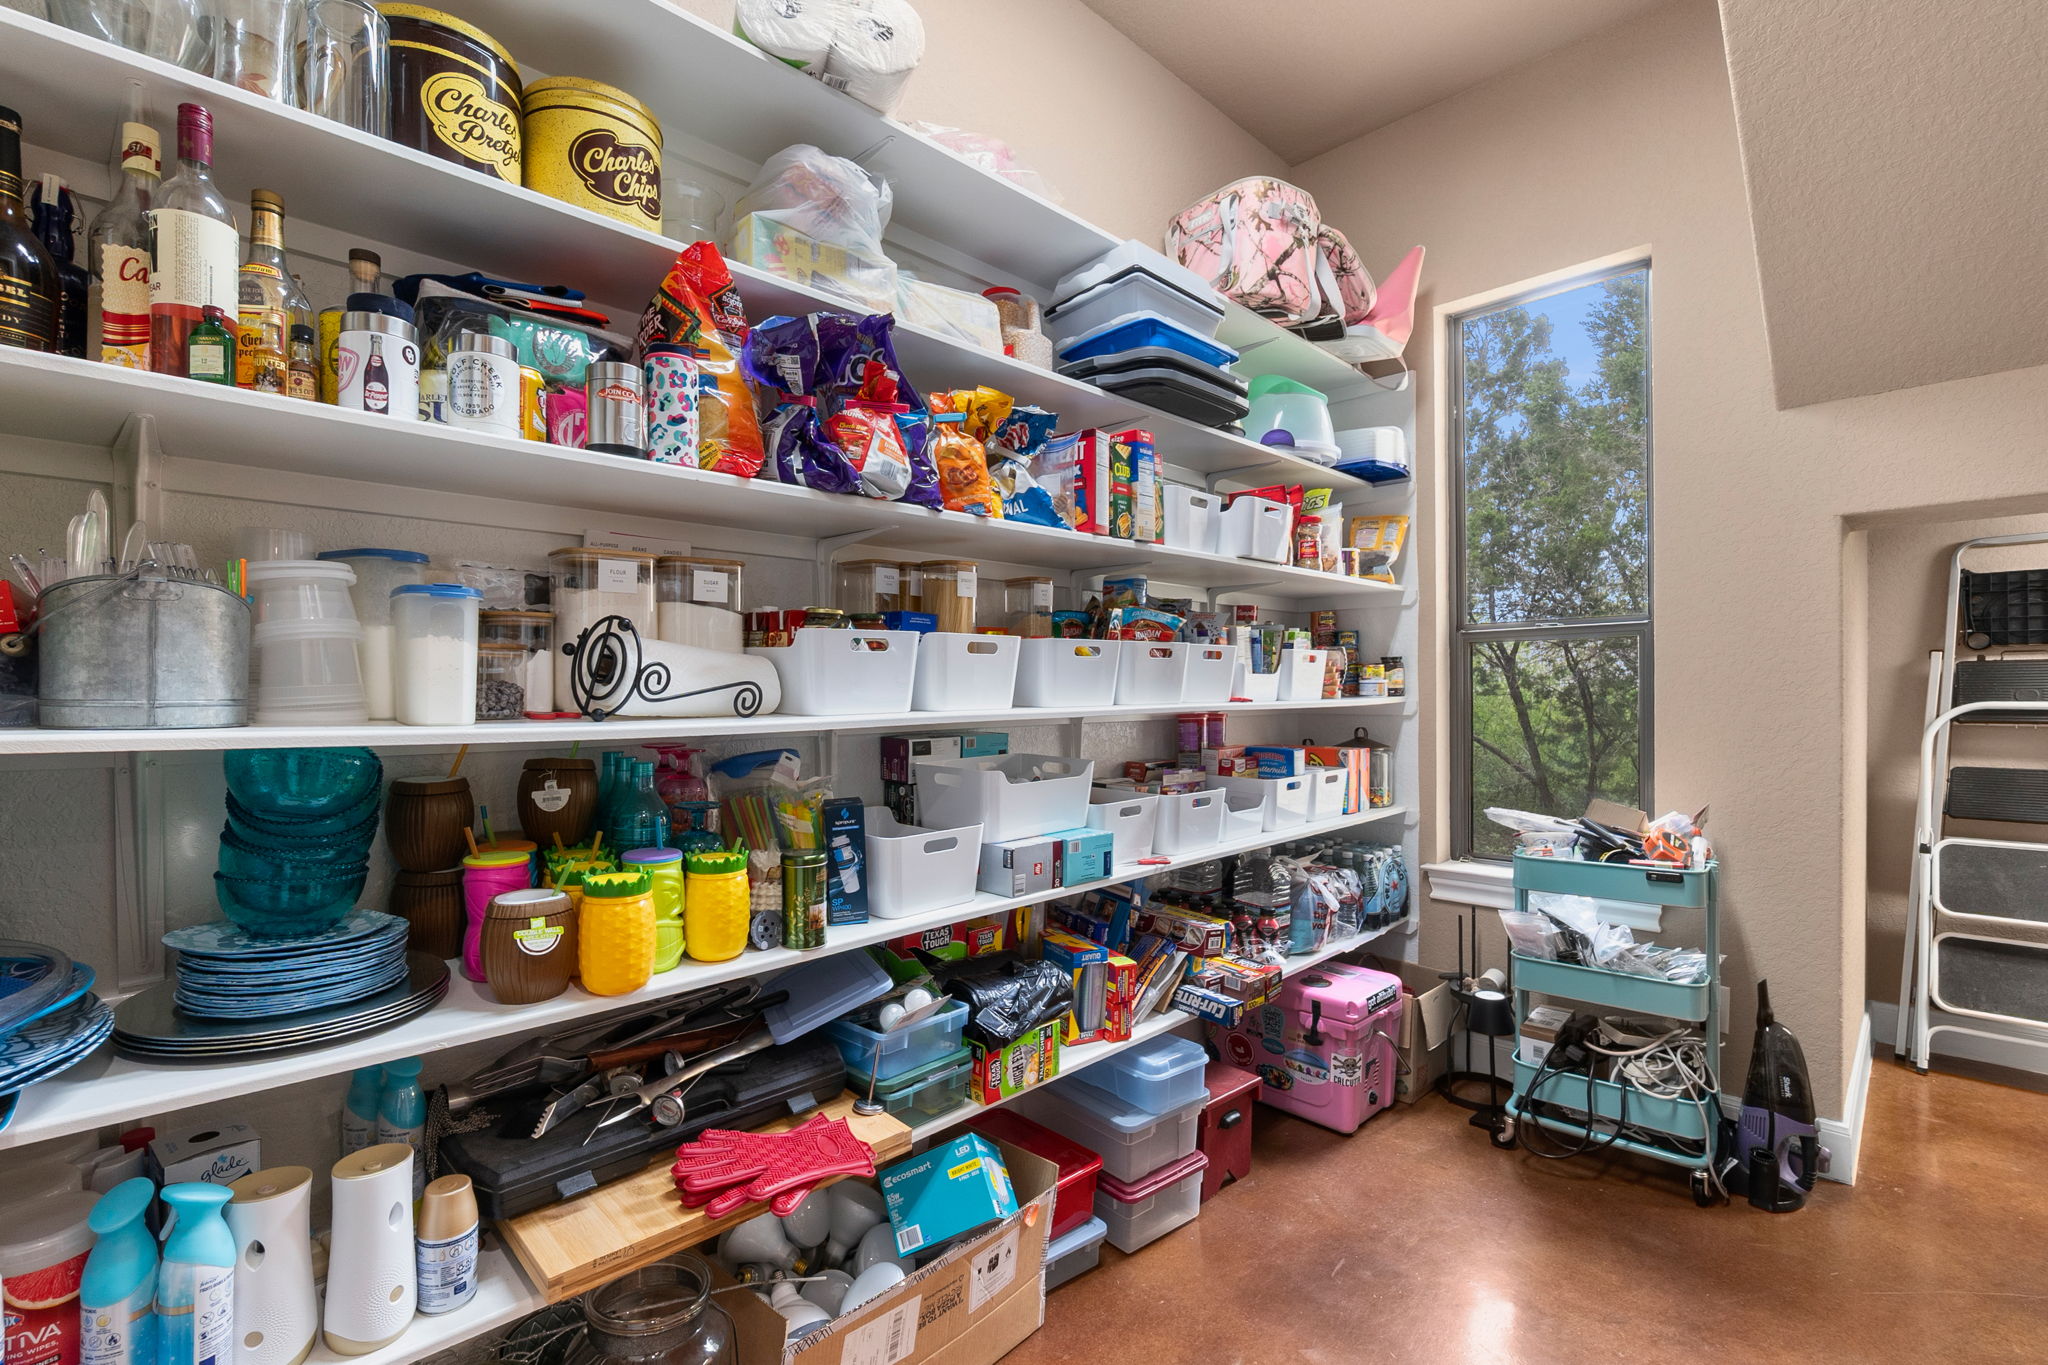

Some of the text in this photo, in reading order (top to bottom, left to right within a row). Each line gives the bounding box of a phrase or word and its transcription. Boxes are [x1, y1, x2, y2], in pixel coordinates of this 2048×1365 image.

[434, 88, 517, 140] Charles
[583, 147, 656, 175] Charles
[614, 174, 659, 205] Chips
[639, 314, 667, 348] RDER
[472, 358, 503, 389] CREEK
[605, 388, 636, 399] JOIN CCA
[452, 403, 495, 416] COLORADO
[1114, 462, 1131, 478] CLUB
[923, 934, 951, 949] TOUGH
[925, 926, 950, 941] TEXAS
[1173, 989, 1227, 1020] CUT-RITE
[1784, 1076, 1792, 1098] Shark
[200, 1155, 249, 1183] glade
[892, 1160, 932, 1184] ecosmart
